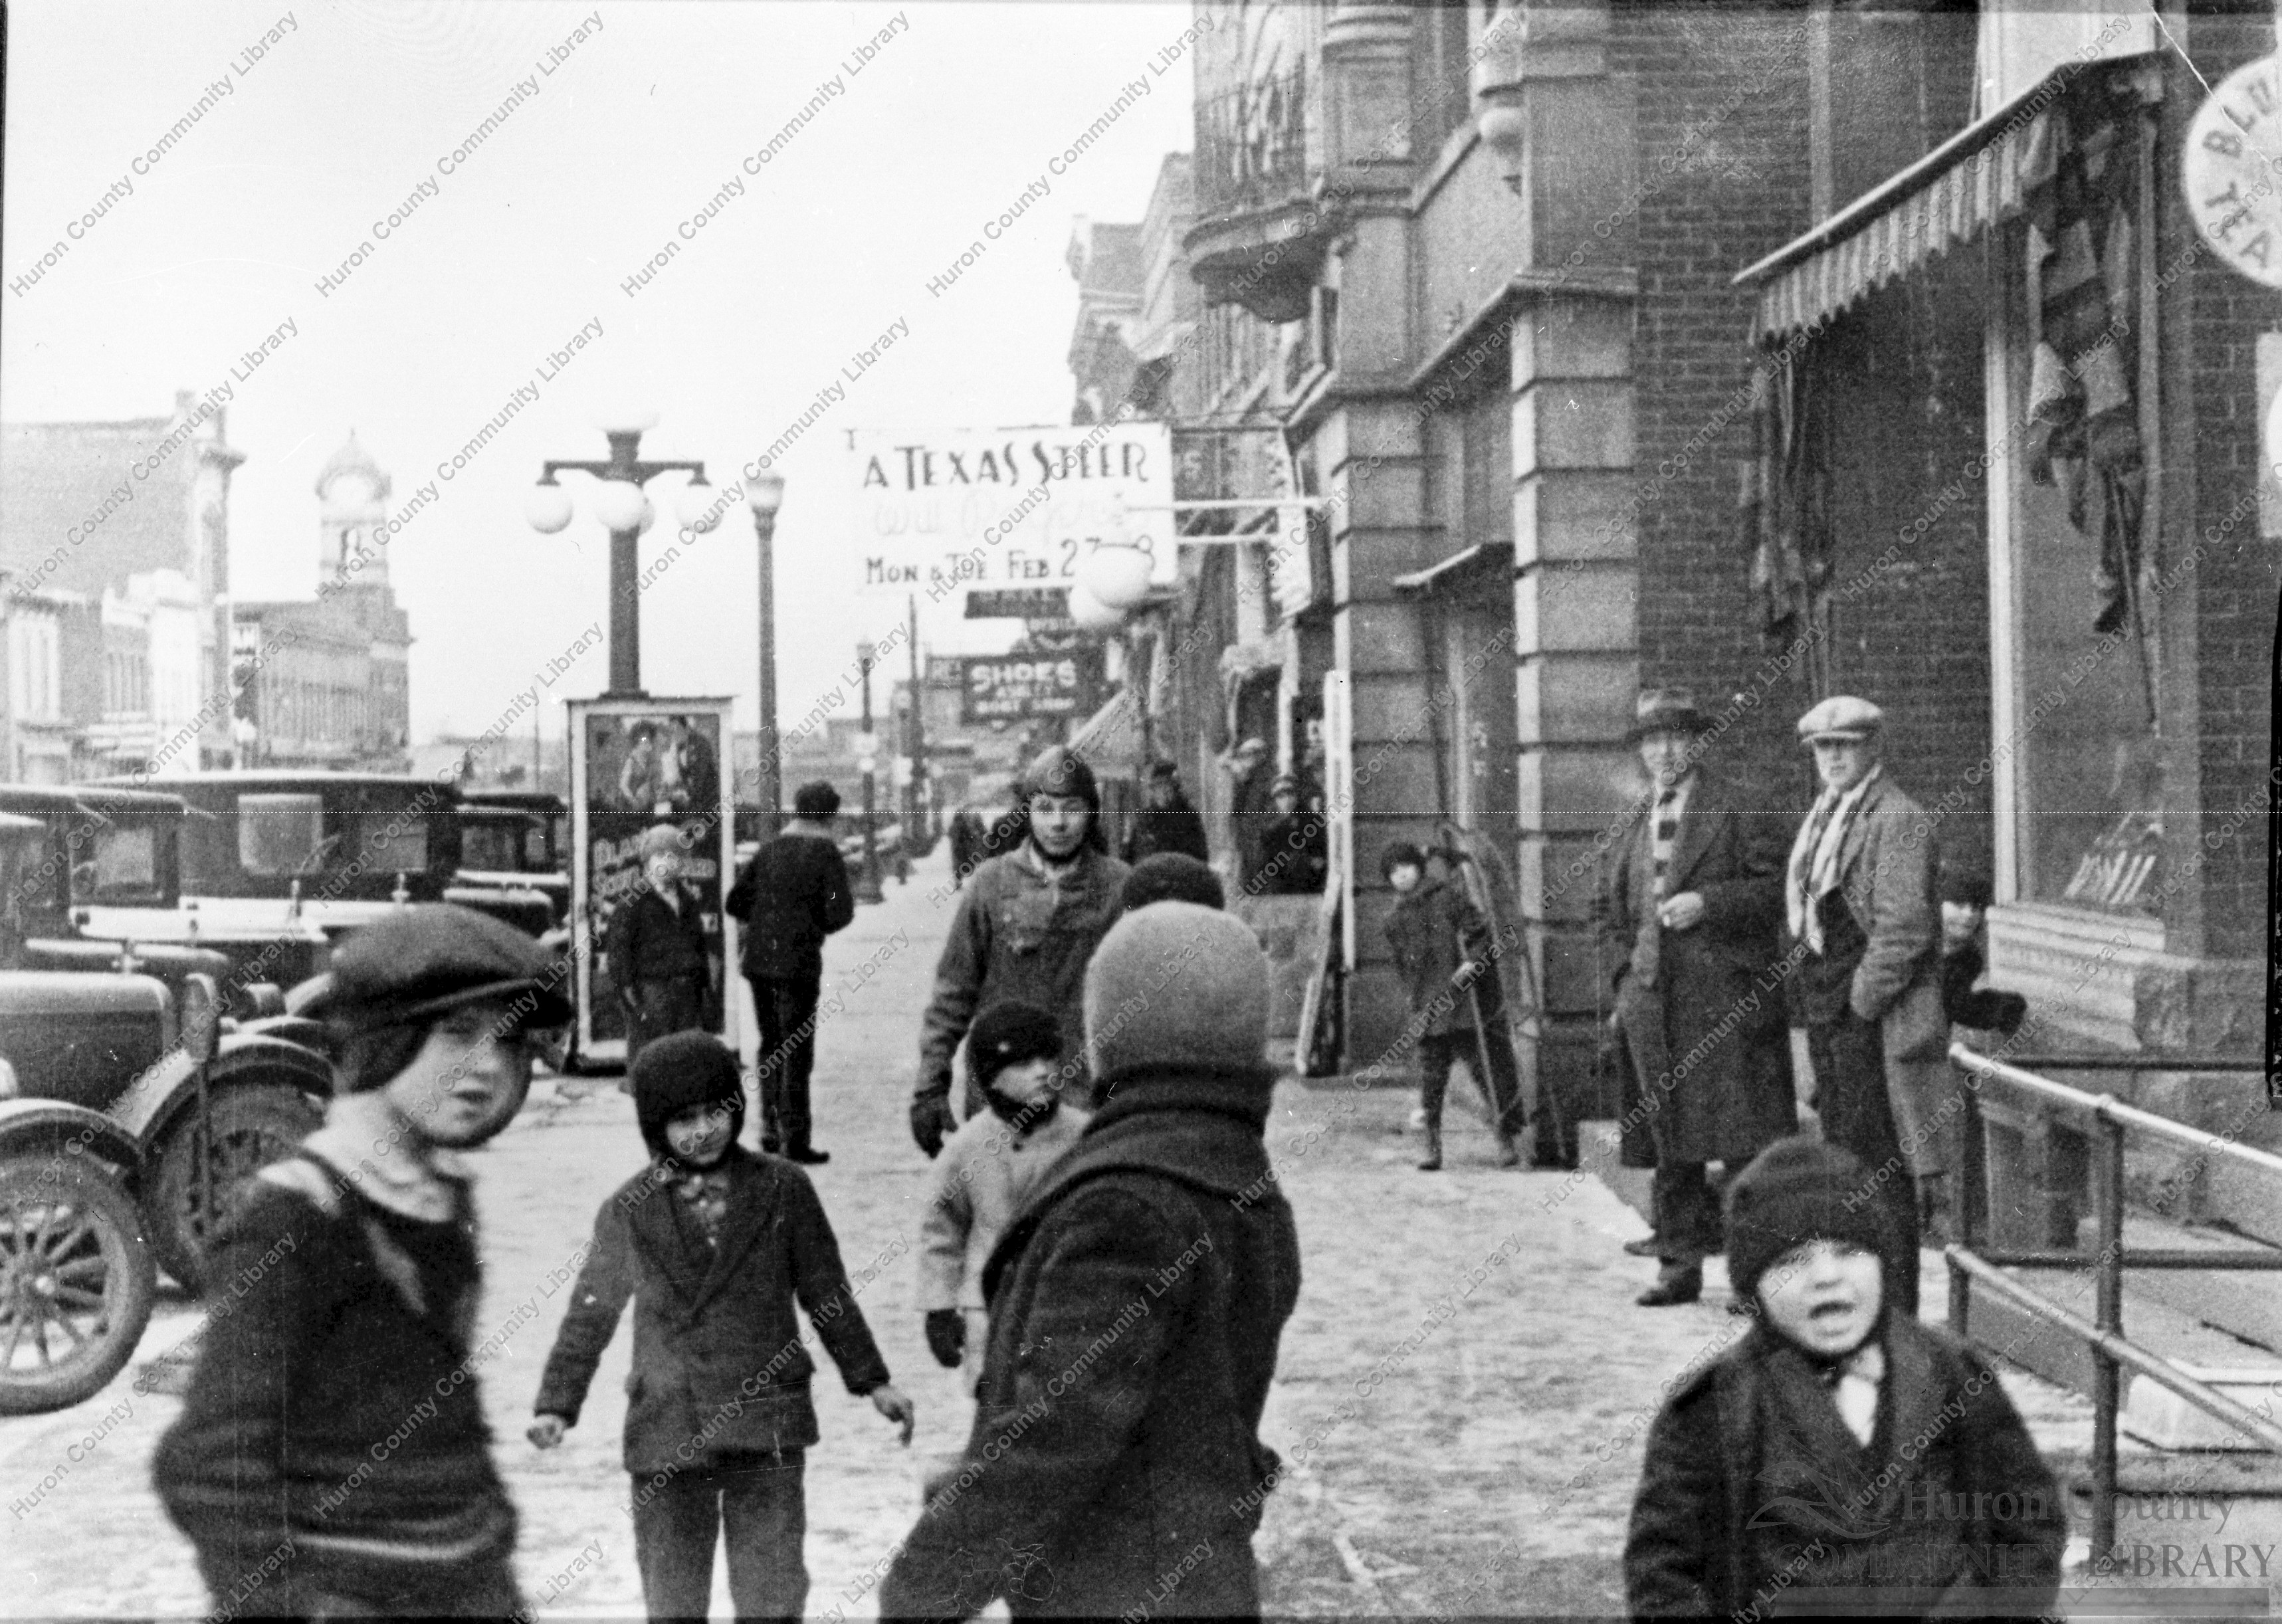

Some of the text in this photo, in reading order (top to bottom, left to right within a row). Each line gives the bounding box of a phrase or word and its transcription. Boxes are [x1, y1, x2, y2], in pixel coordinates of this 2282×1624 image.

[864, 456, 888, 488] A
[894, 442, 1019, 491] TEXAS
[1031, 441, 1148, 486] STEER
[970, 659, 1077, 693] SHOES
